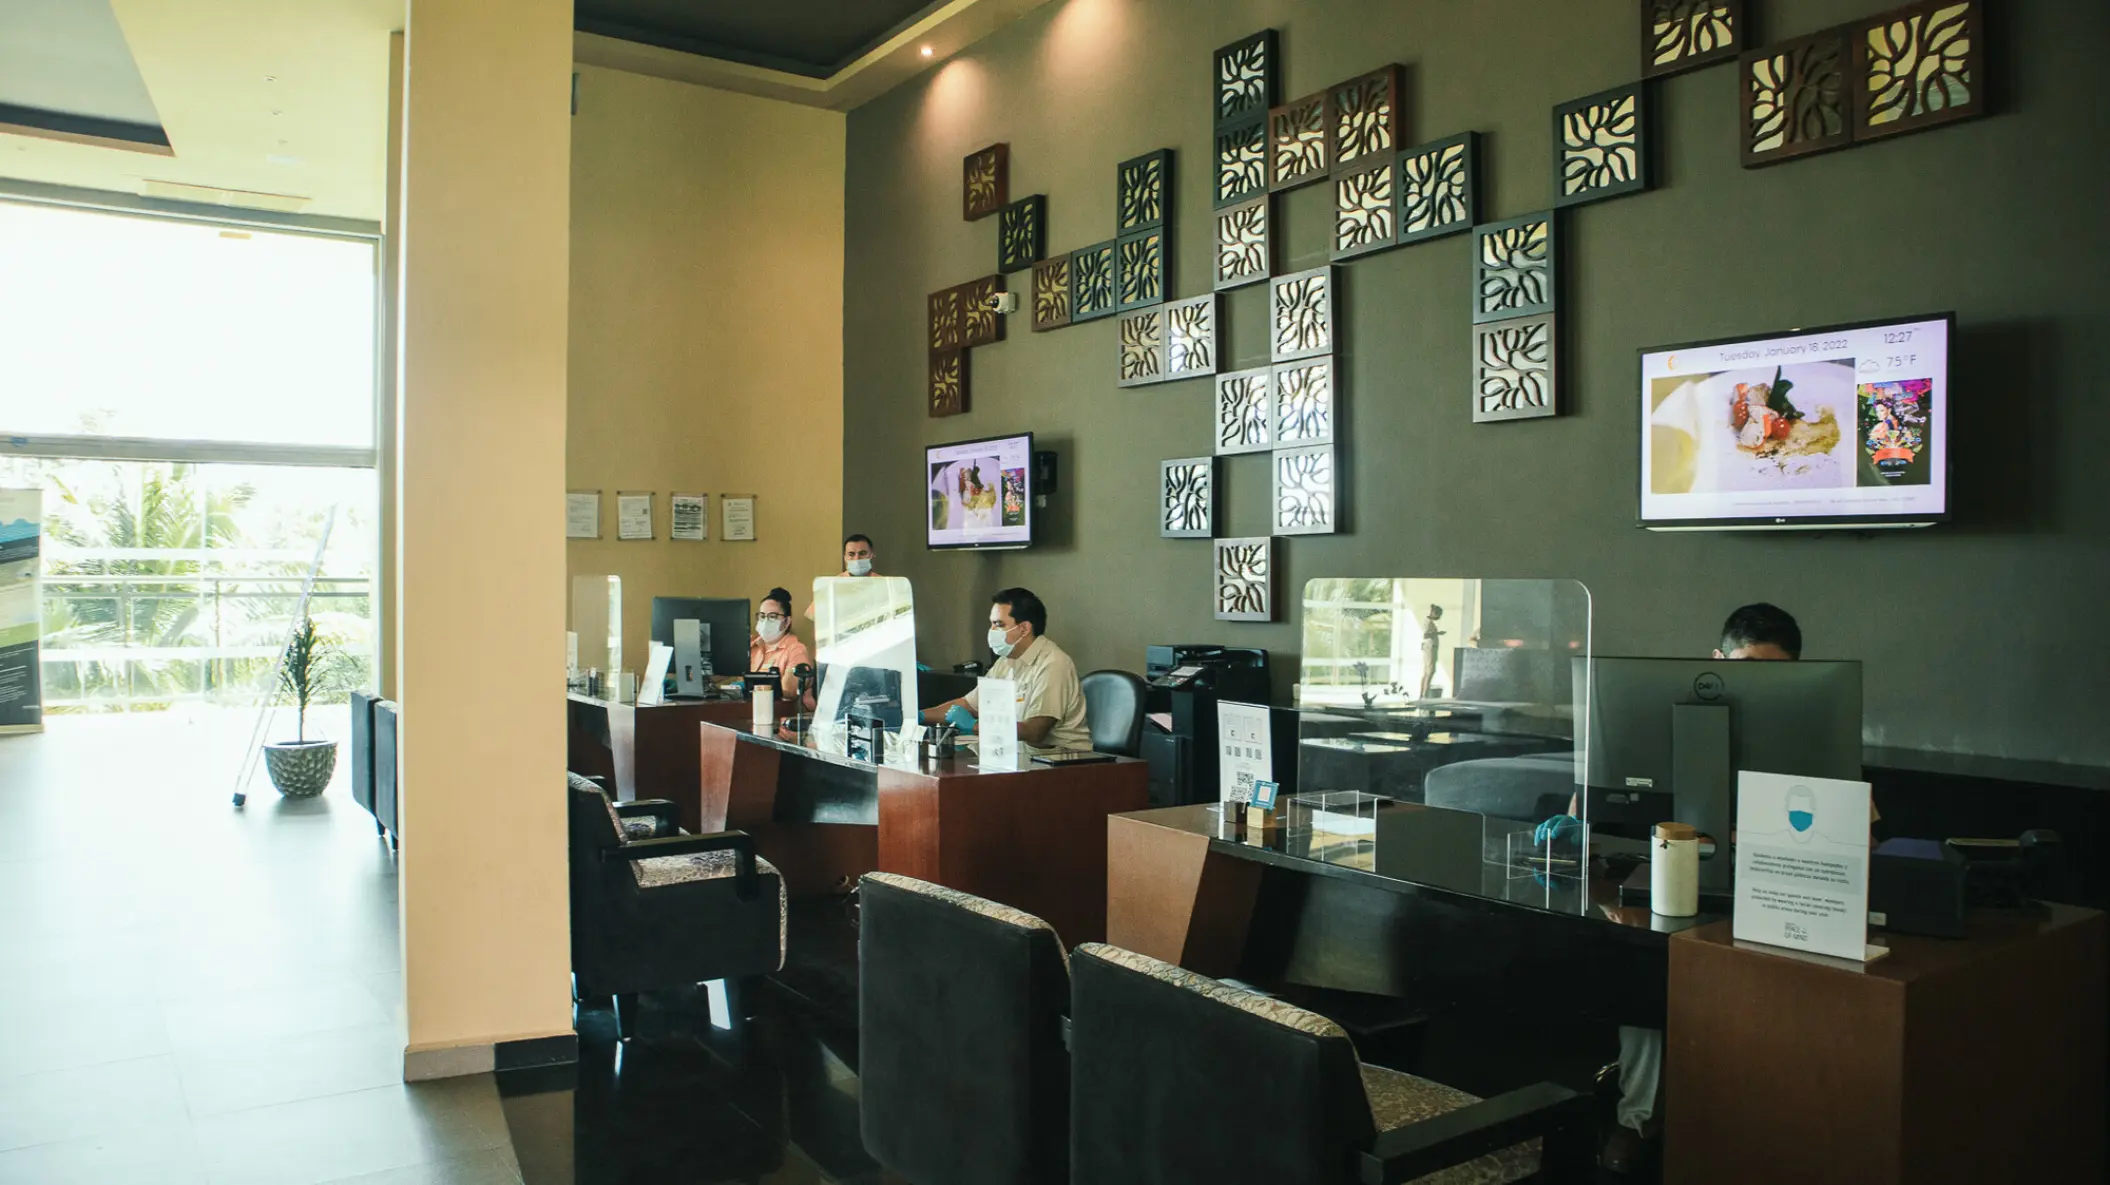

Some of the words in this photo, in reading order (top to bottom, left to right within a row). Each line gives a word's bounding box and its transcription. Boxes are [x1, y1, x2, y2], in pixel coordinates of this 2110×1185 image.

[1884, 331, 1912, 344] 12:27
[1764, 345, 1807, 358] January
[1822, 339, 1848, 351] 2022
